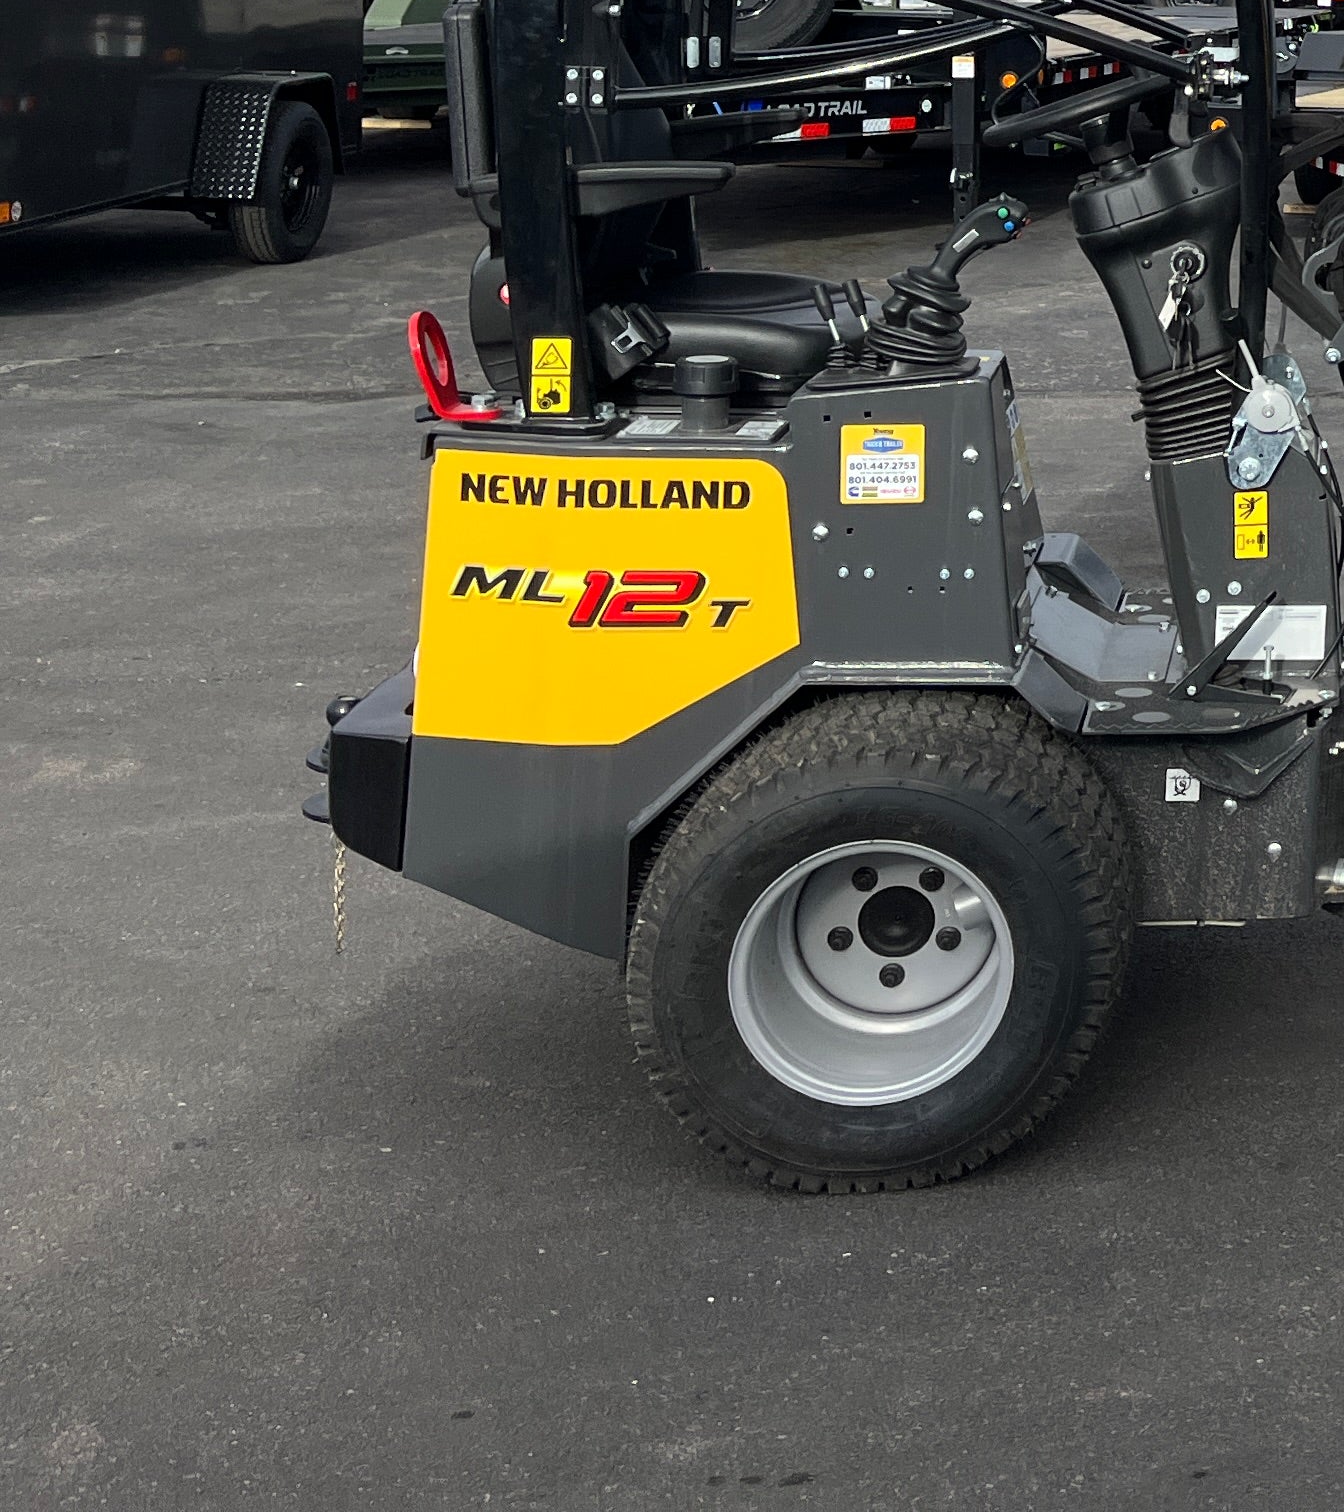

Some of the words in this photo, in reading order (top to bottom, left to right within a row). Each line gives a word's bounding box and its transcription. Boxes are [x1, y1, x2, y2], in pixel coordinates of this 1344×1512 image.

[817, 99, 868, 117] TRAIL
[849, 461, 916, 471] 801.447.2753
[848, 475, 917, 484] 801.404.6991
[460, 473, 548, 507] NEW
[557, 479, 750, 510] HOLLAND
